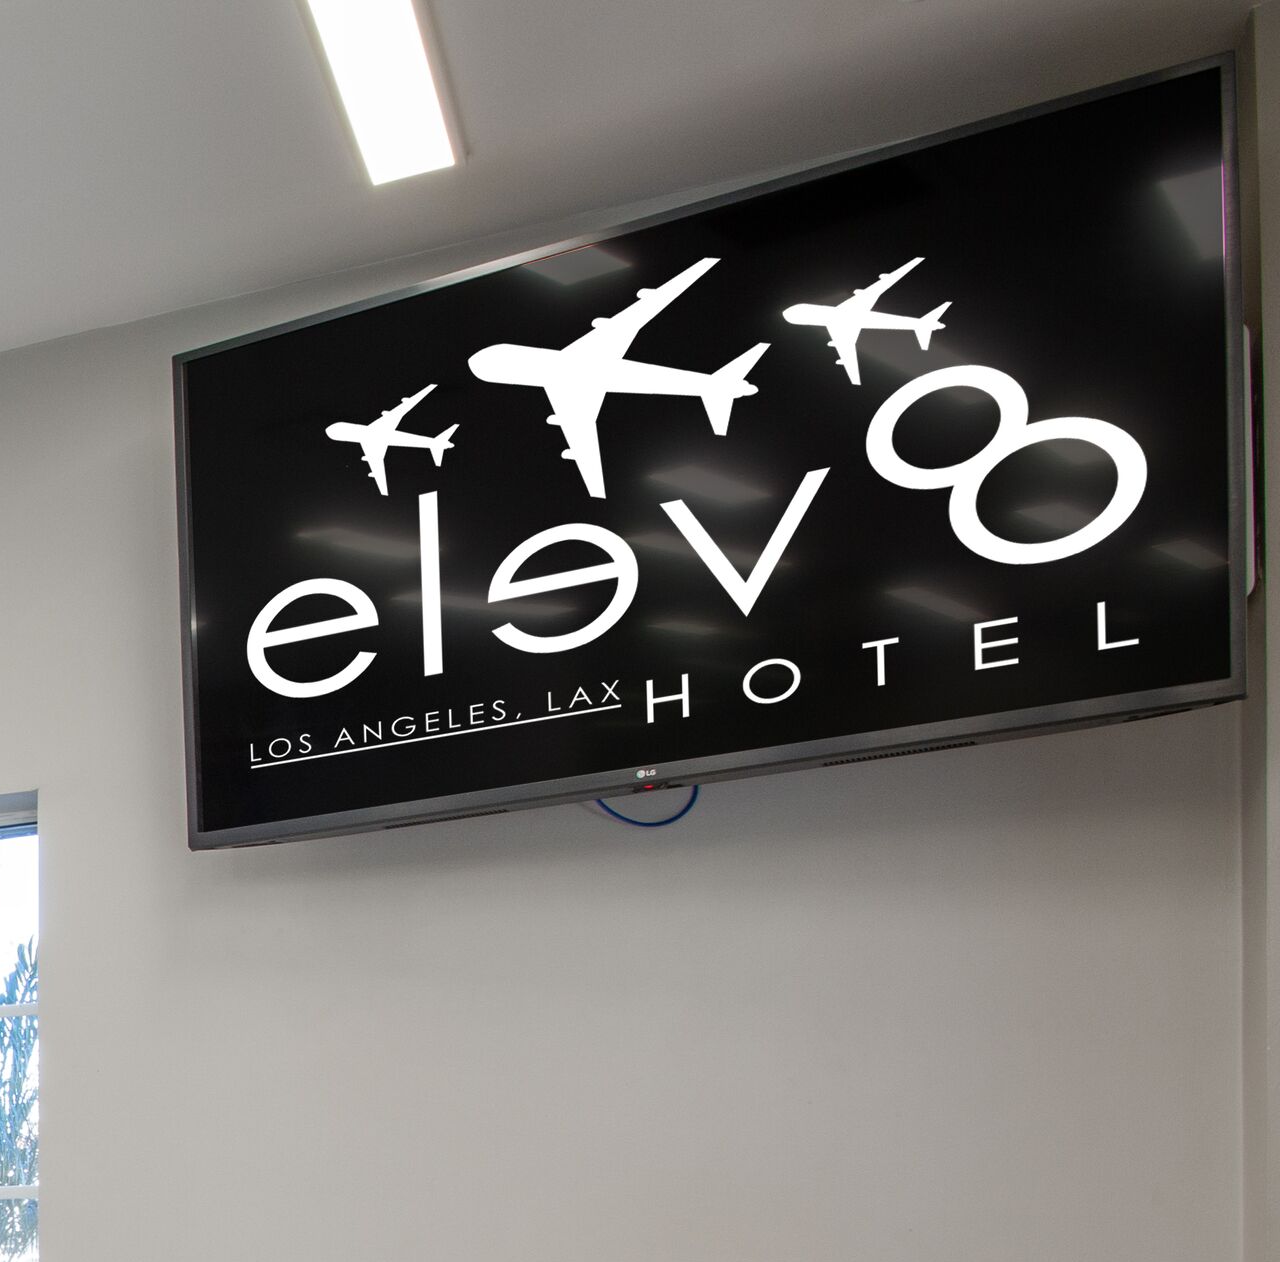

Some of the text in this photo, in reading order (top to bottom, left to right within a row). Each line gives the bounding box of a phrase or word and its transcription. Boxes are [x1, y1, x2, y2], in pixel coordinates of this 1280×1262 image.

[646, 602, 1140, 724] HOTEL
[251, 680, 621, 762] LOS ANGELES, LAX
